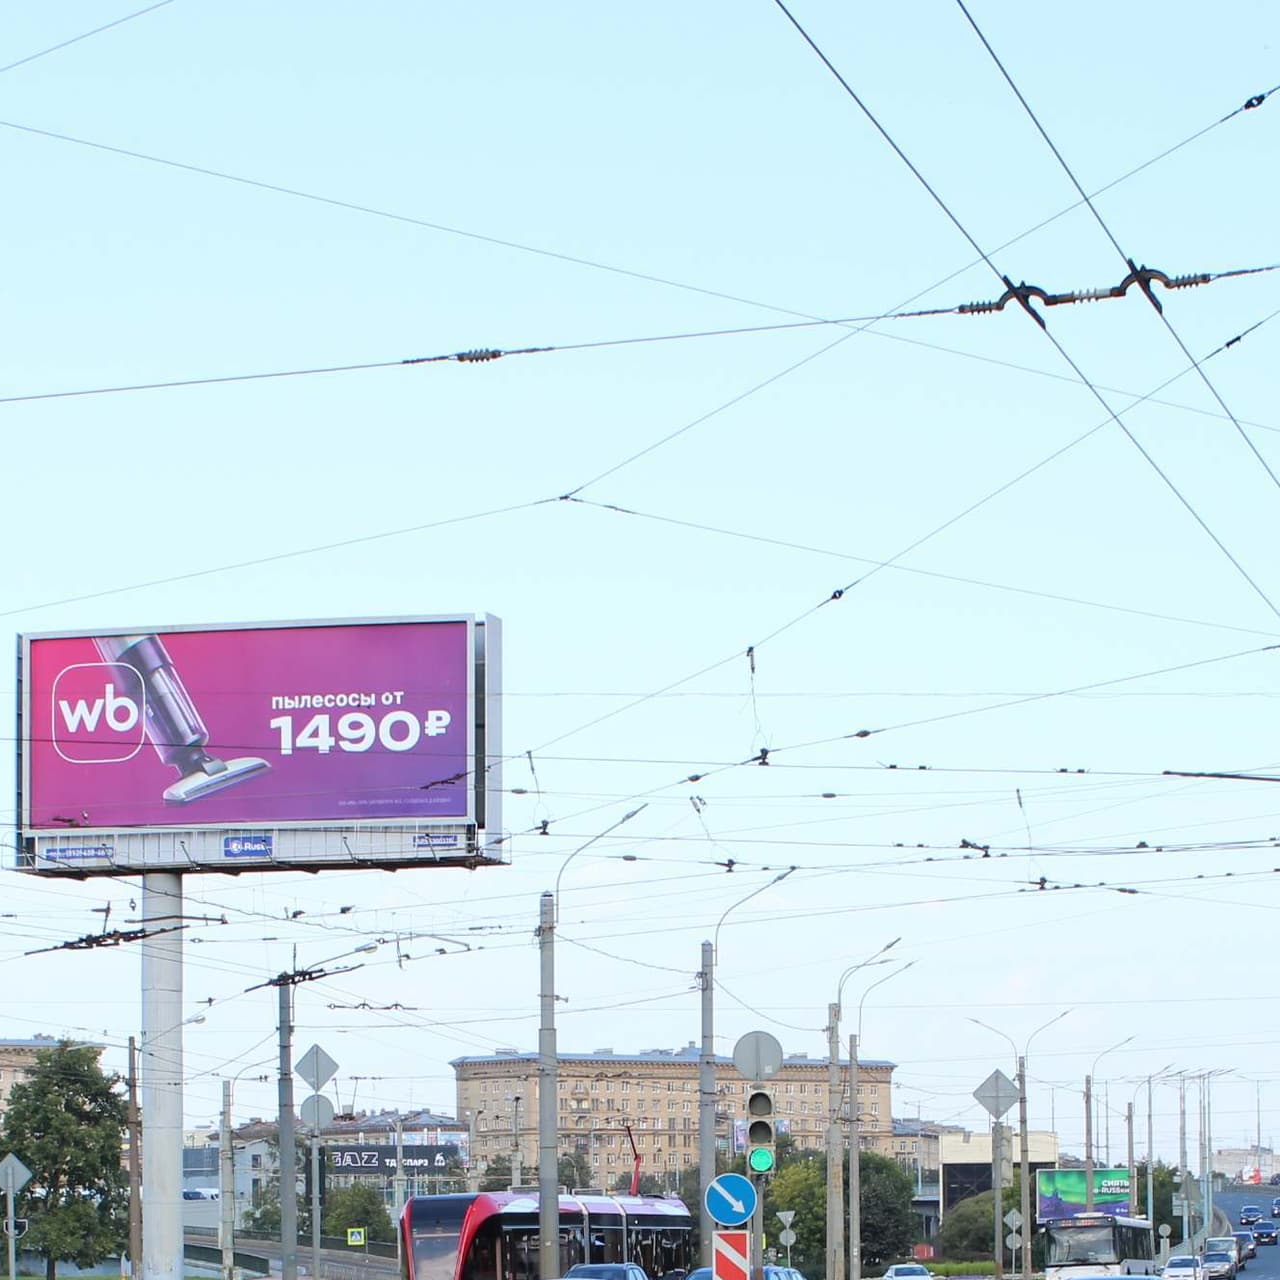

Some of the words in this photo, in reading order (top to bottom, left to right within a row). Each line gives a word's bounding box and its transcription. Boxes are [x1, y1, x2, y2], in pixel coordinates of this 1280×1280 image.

[58, 683, 139, 733] wb
[272, 692, 376, 710] пылесосы
[381, 691, 404, 706] от
